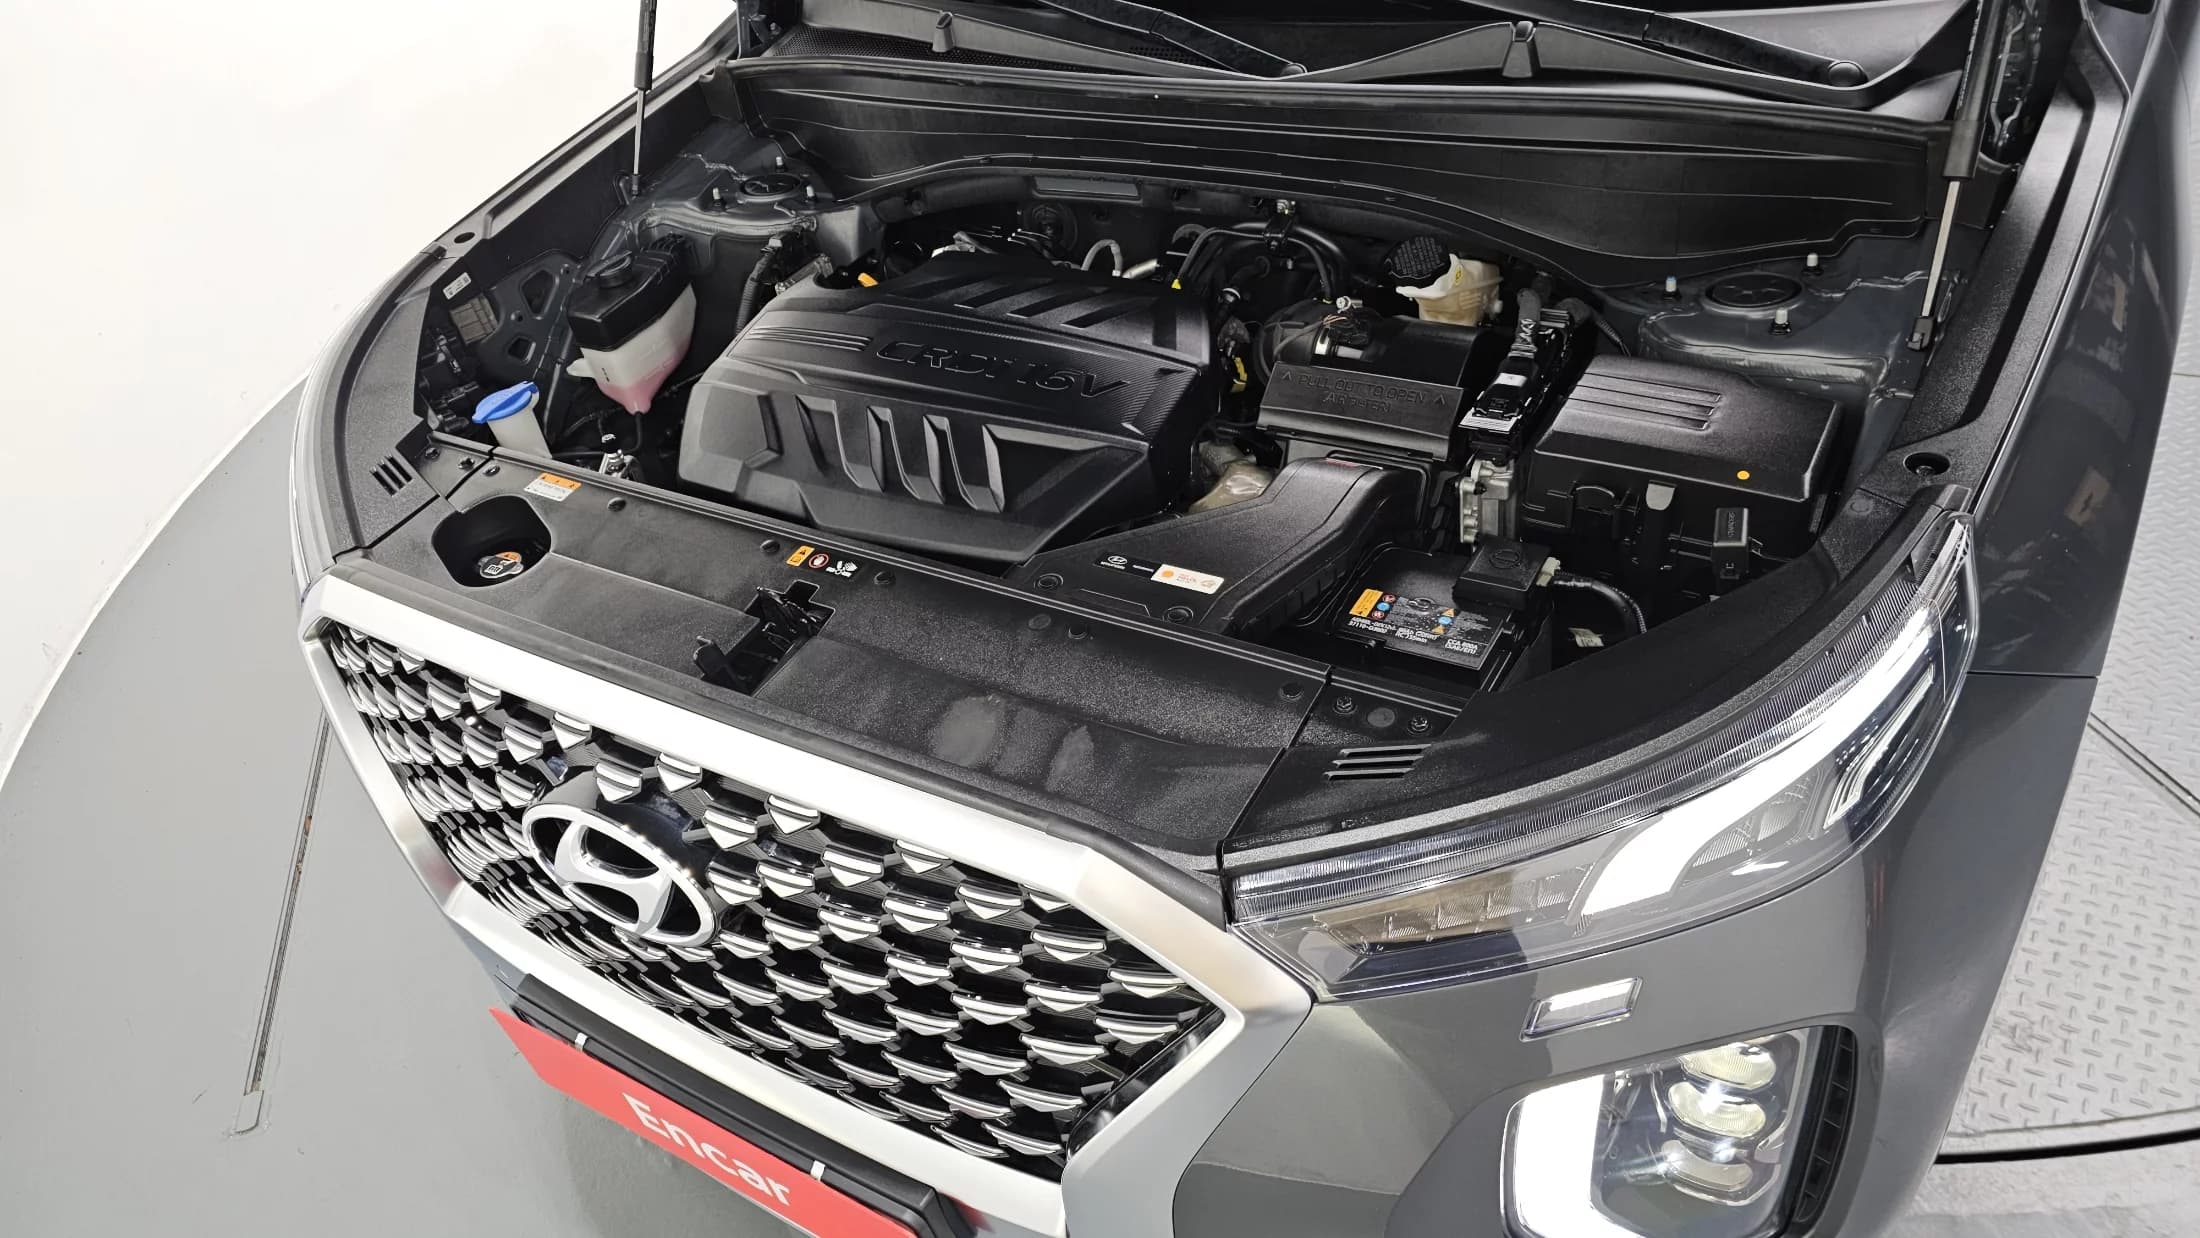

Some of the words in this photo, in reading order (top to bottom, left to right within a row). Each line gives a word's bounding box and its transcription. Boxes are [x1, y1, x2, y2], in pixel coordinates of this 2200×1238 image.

[1299, 373, 1333, 390] PULL
[1335, 376, 1361, 393] OUT
[1367, 382, 1384, 397] TO
[1386, 385, 1427, 404] OPEN
[623, 1092, 791, 1206] Encar
